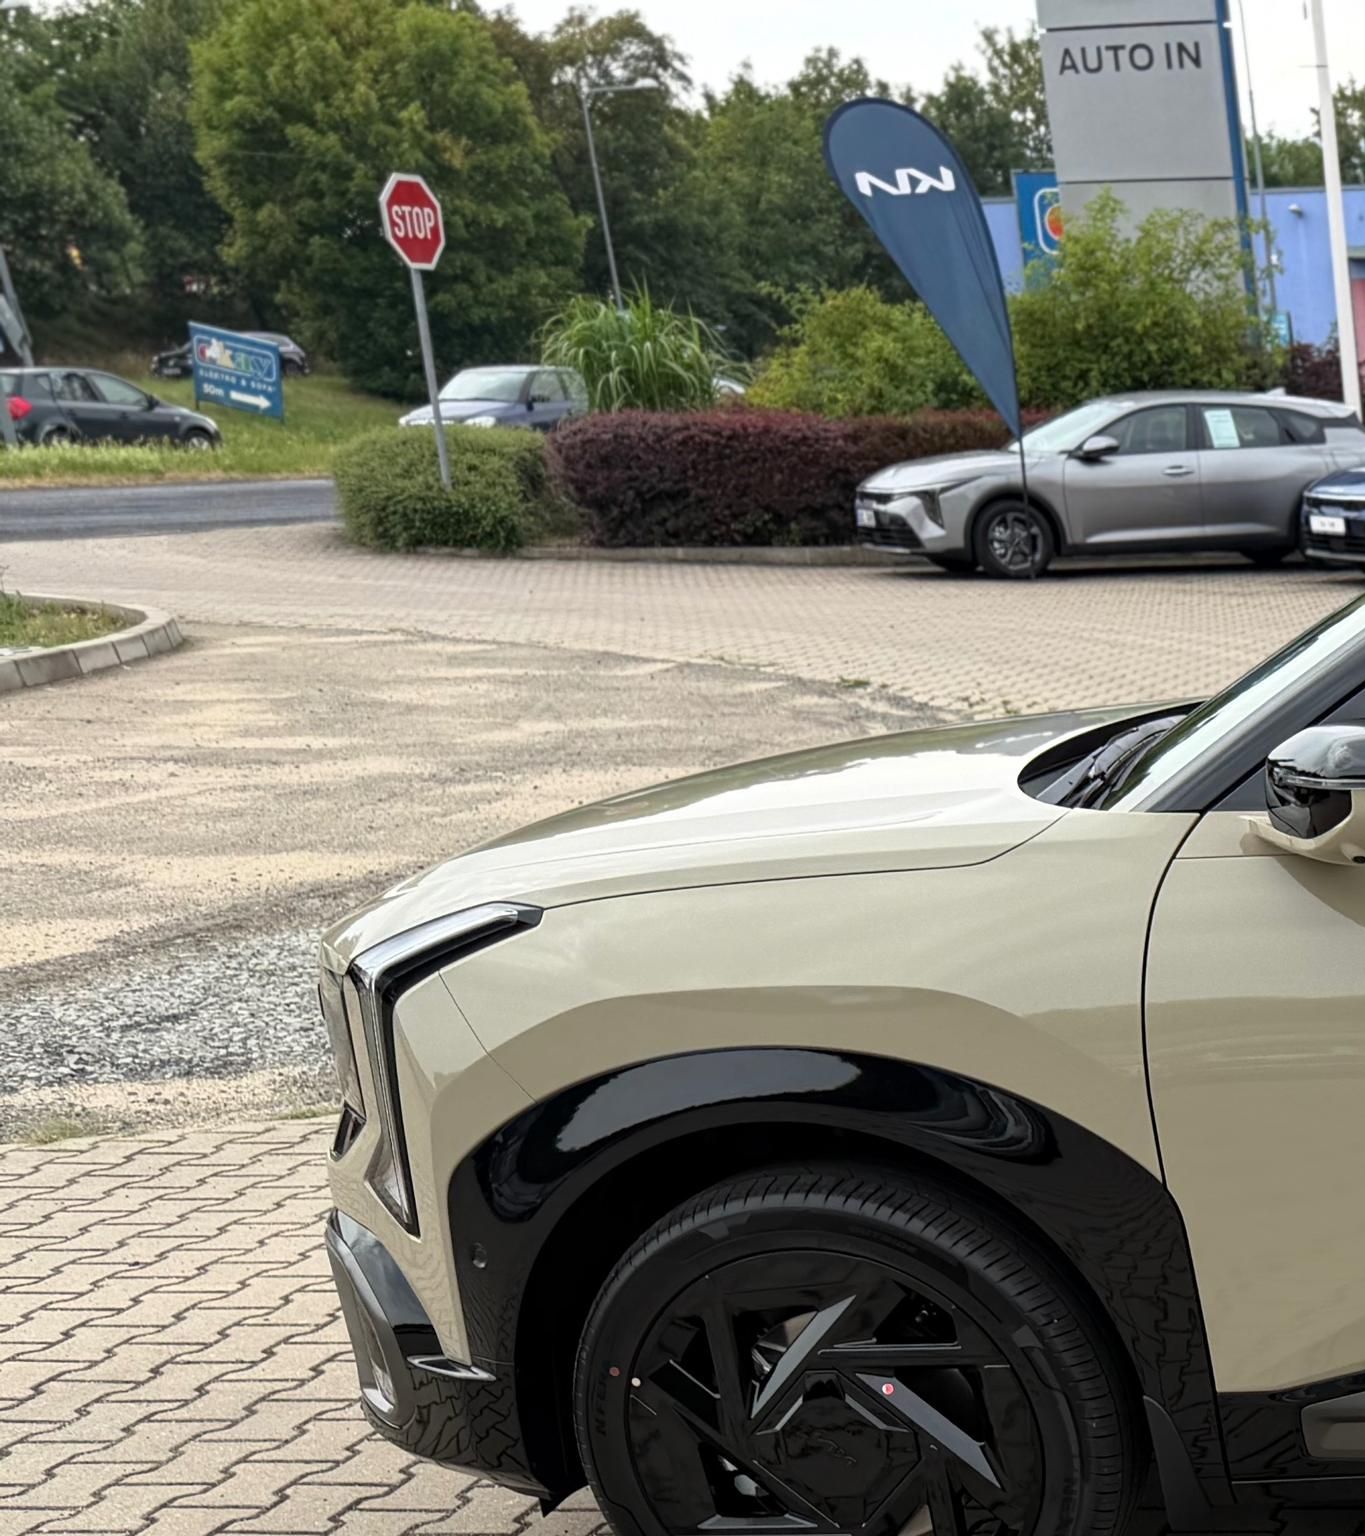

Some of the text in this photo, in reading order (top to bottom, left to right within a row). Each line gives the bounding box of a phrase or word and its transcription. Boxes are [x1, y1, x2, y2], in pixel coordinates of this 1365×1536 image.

[1059, 41, 1202, 75] AUTO IN
[392, 205, 435, 239] STOP
